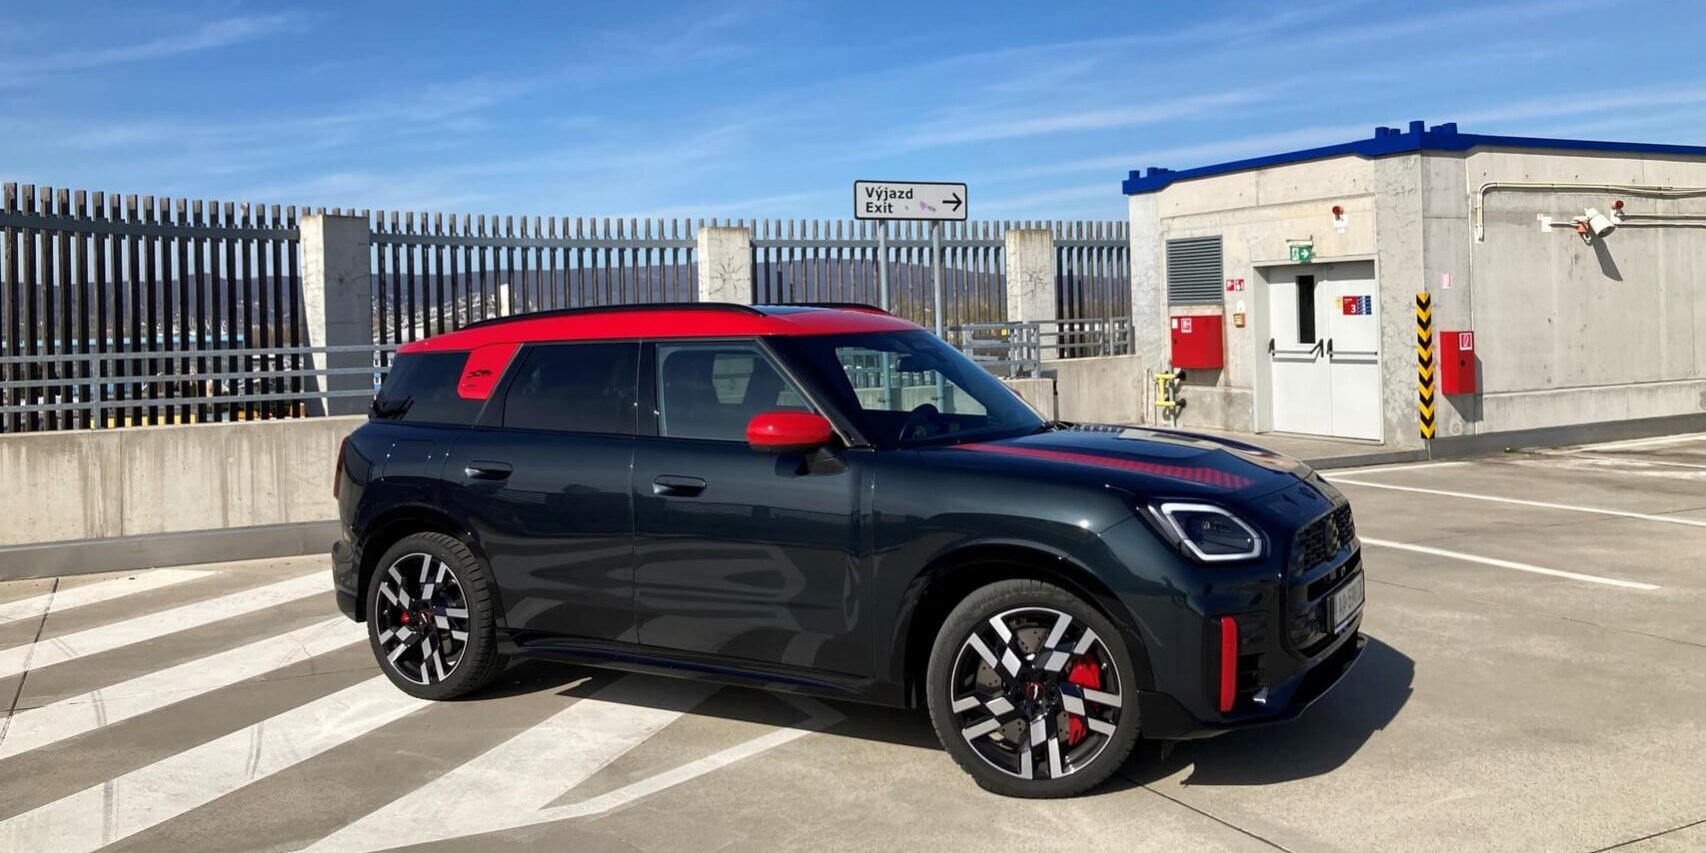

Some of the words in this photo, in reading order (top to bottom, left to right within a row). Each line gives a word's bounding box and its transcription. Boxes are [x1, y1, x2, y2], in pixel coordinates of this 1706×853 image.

[865, 186, 913, 201] Výjazd
[866, 202, 894, 214] Exit
[1350, 304, 1356, 313] 3
